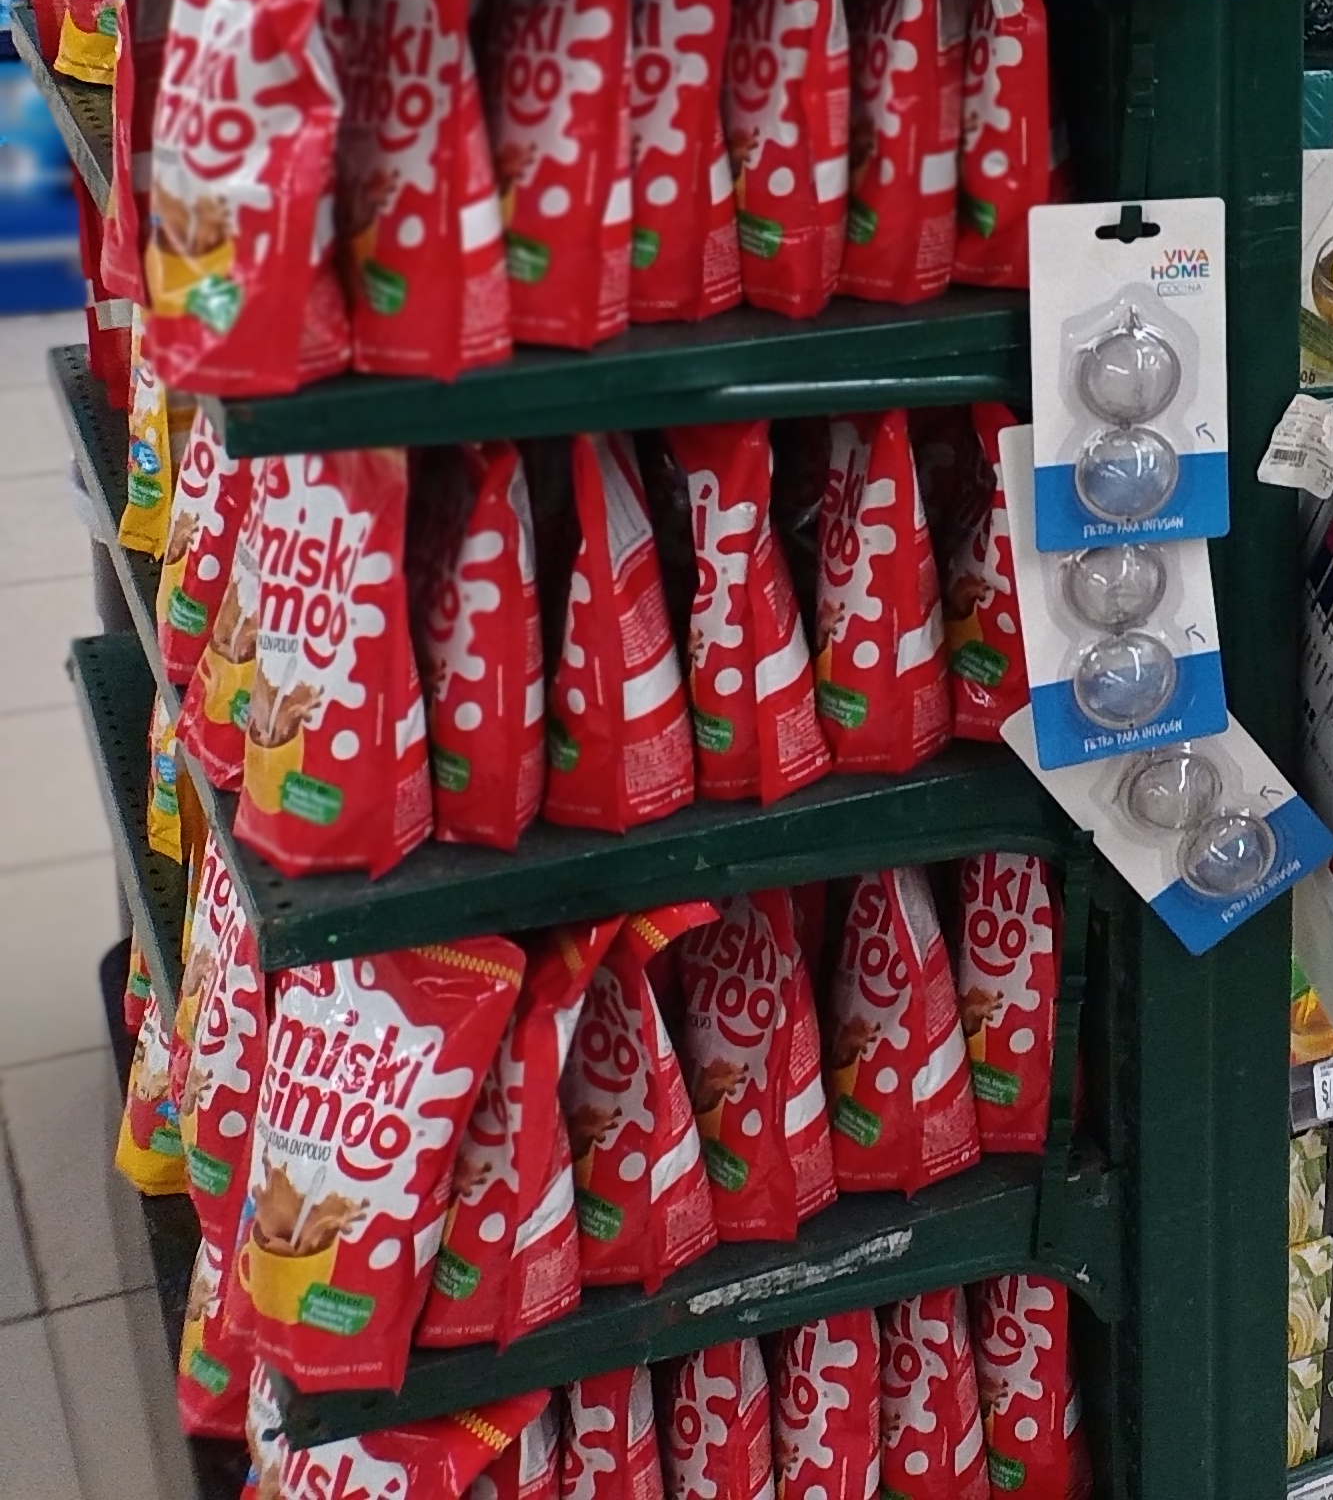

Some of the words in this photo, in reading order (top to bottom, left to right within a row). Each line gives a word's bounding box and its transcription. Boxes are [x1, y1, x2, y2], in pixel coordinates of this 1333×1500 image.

[1164, 248, 1209, 264] VIVA
[1150, 262, 1211, 280] HOME
[1160, 282, 1203, 295] COCINA
[1083, 520, 1113, 537] FILTRO
[1113, 519, 1139, 534] PARA
[1114, 729, 1139, 747] PARA
[272, 1009, 437, 1111] miski
[260, 1064, 412, 1161] simoo
